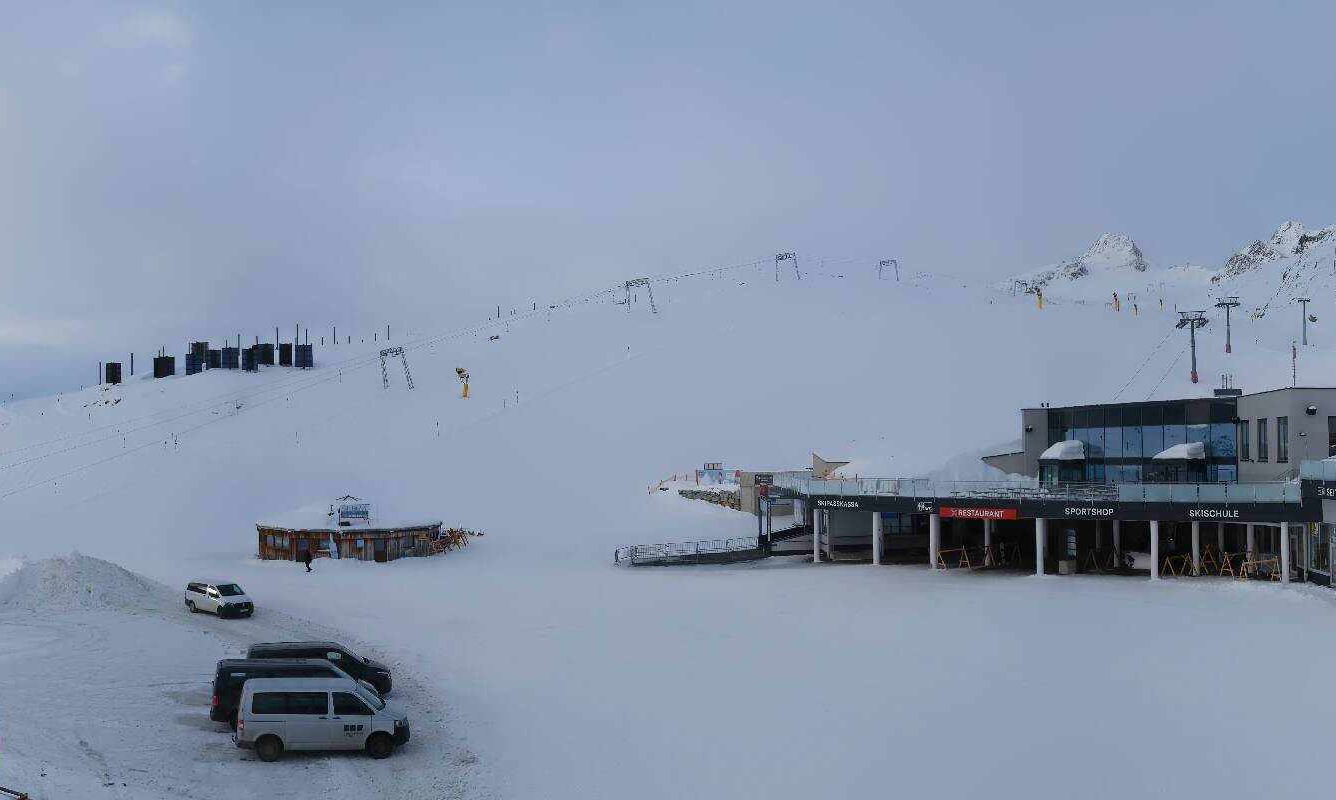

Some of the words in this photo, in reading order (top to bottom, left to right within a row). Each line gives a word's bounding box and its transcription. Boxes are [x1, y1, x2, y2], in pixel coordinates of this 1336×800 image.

[817, 500, 859, 508] SKIPASSKASSA
[958, 508, 1004, 518] RESTAURANT
[1064, 507, 1114, 516] SPORTSHOP
[1189, 509, 1240, 518] SKISCHULE
